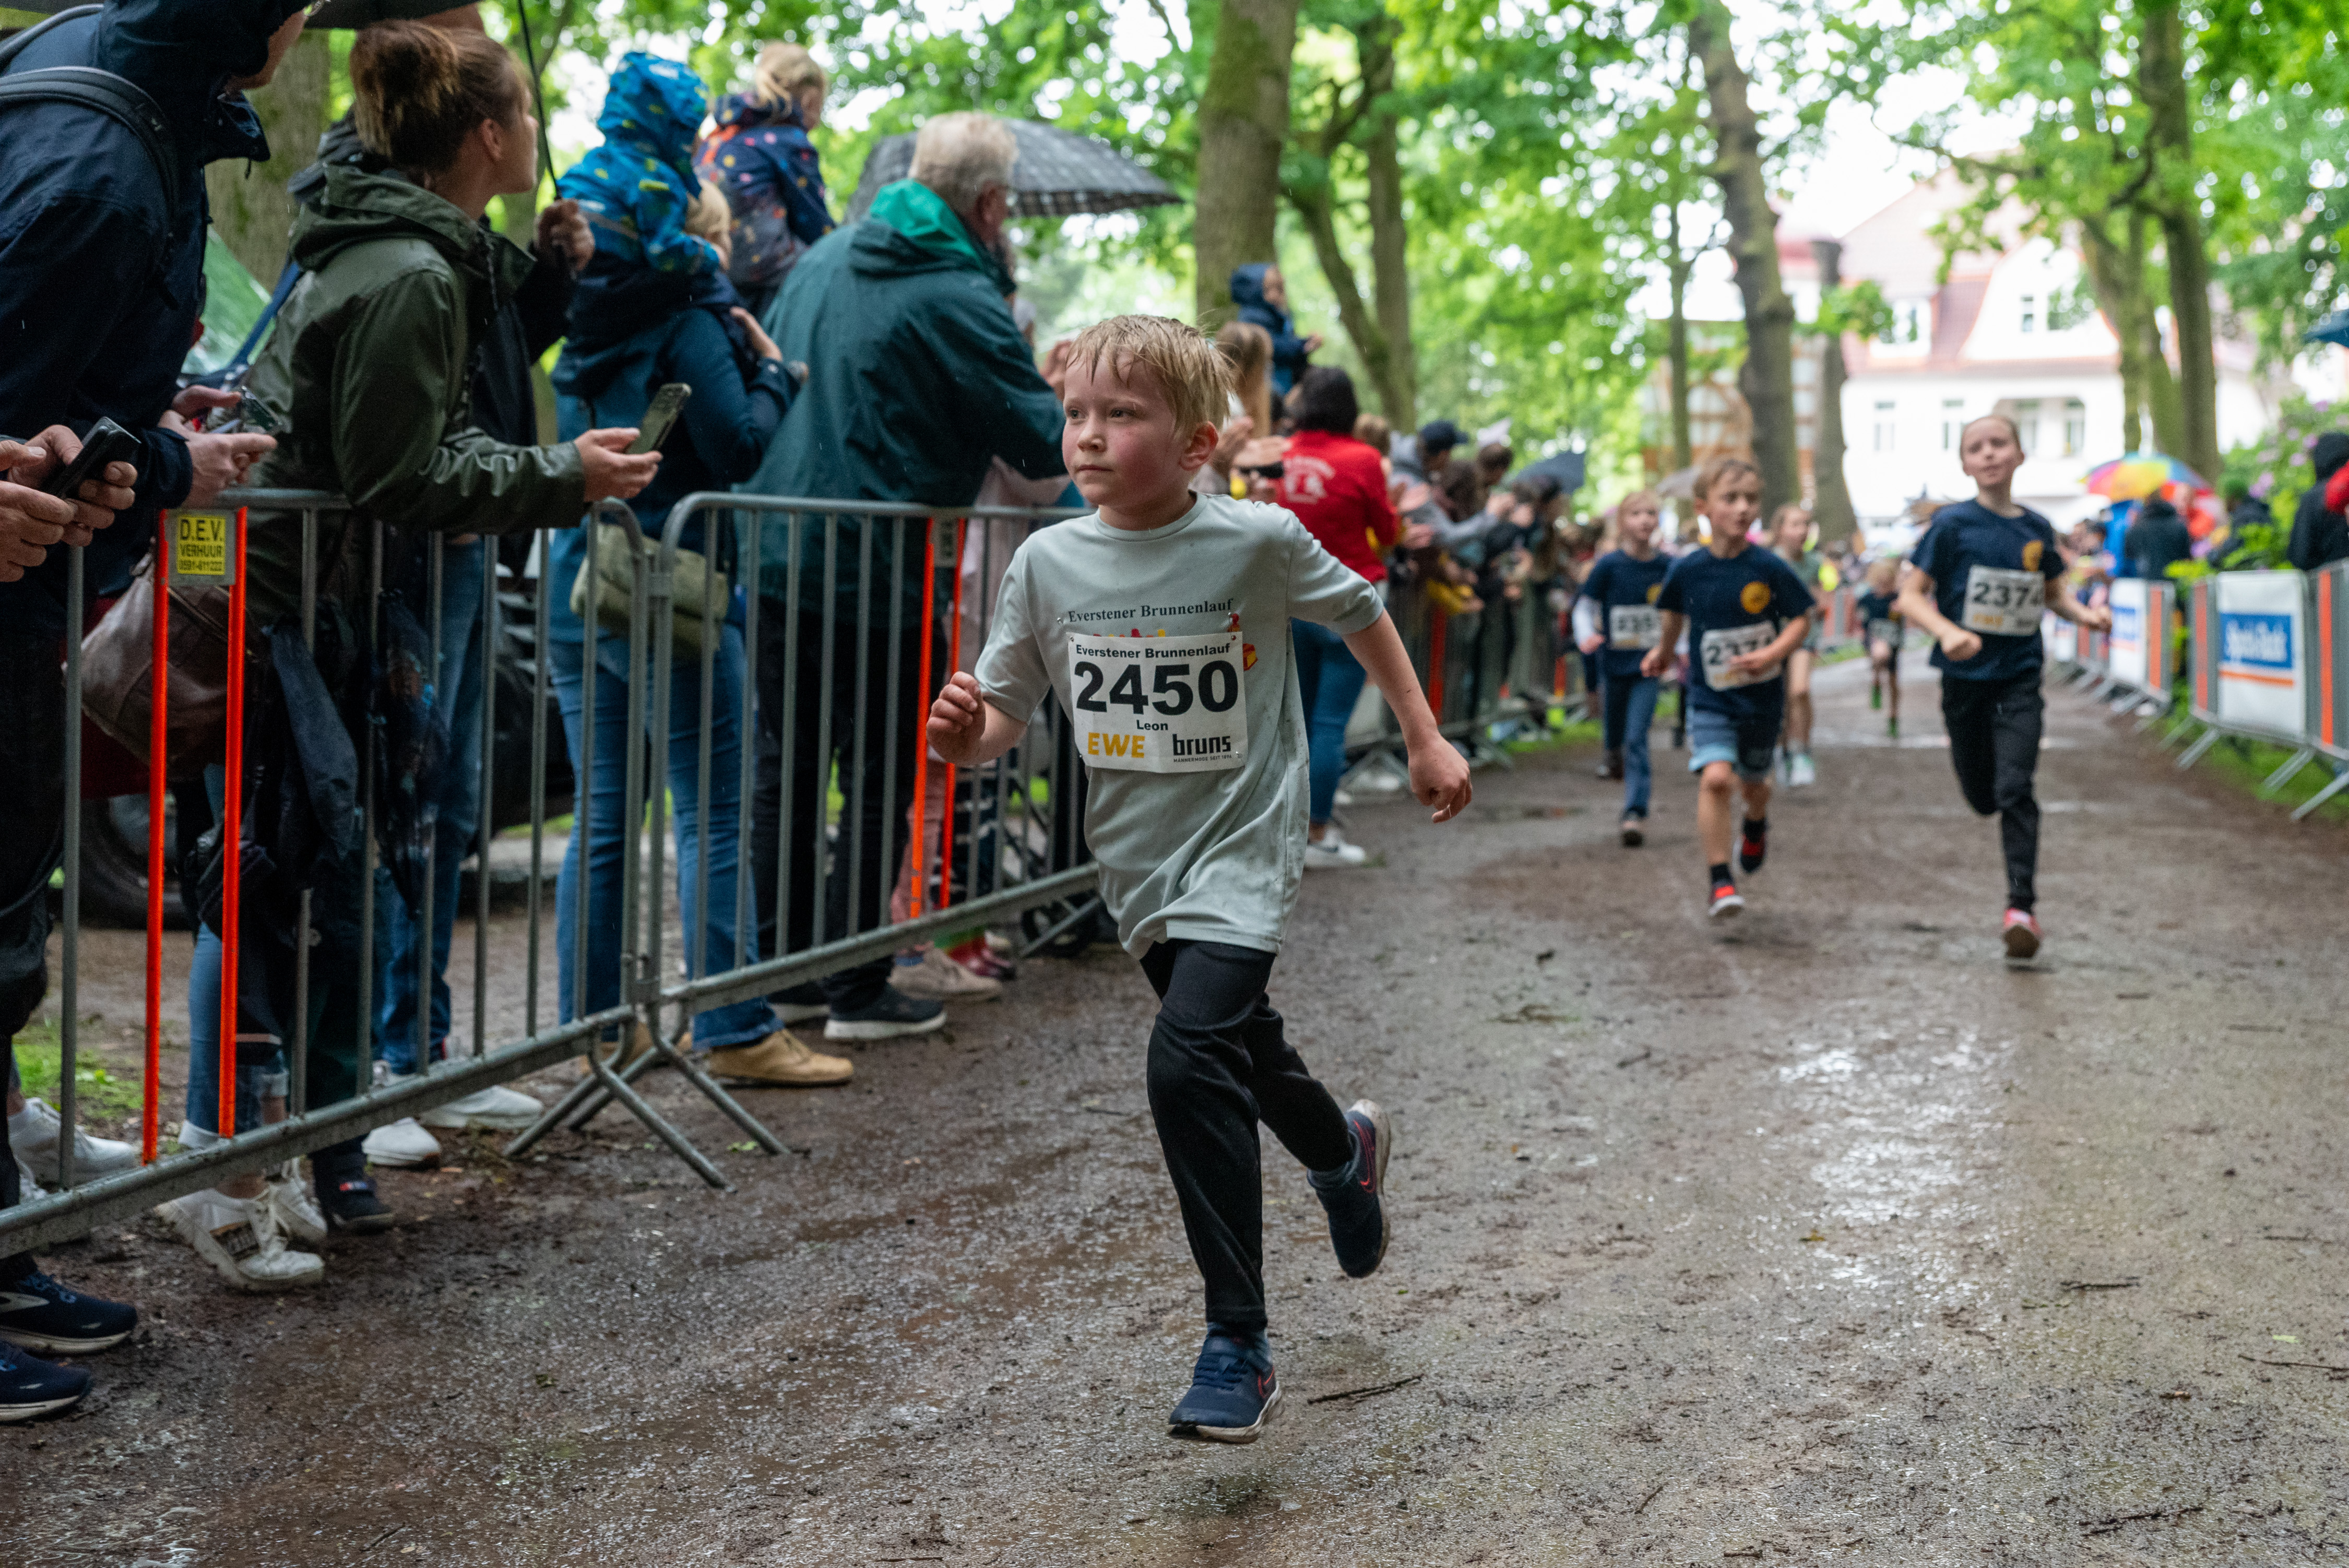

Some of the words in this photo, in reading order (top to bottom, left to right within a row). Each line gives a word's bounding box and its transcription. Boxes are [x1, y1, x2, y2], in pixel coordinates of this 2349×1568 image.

[180, 519, 222, 541] D.E.V.
[180, 544, 222, 557] VERHUUR
[1069, 608, 1136, 622] Everstener
[1141, 598, 1233, 617] Brunnenlauf
[1076, 644, 1141, 658] Everstener
[1145, 643, 1230, 658] Brunnenlauf
[1074, 660, 1239, 716] 2450
[1136, 719, 1168, 731] Leon
[1087, 732, 1145, 758] EWE
[1172, 733, 1231, 756] bruns
